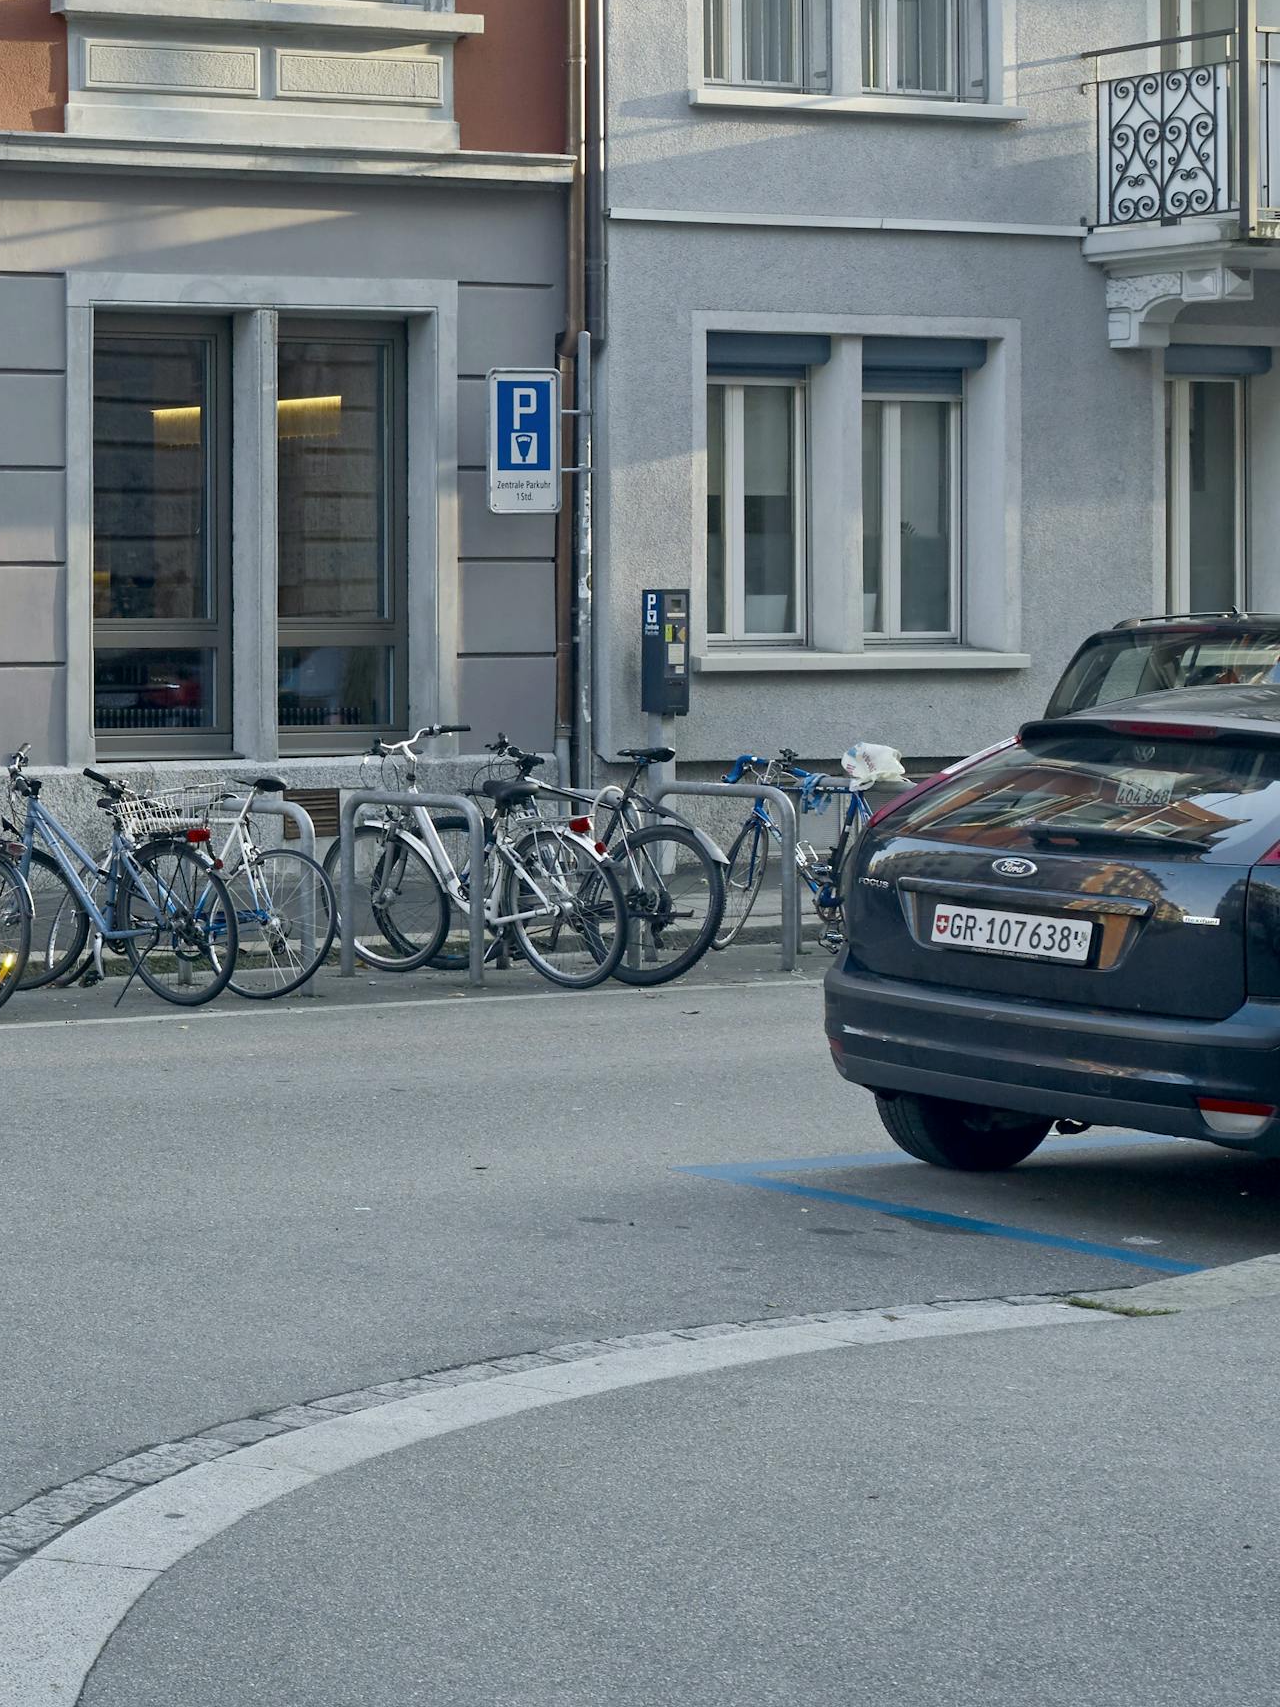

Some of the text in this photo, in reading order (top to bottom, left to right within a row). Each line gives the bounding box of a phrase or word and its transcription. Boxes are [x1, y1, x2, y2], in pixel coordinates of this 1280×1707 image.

[513, 387, 537, 430] P
[497, 480, 551, 489] Zentrale Parkuhr
[647, 594, 657, 610] P
[858, 877, 889, 889] FOCUS
